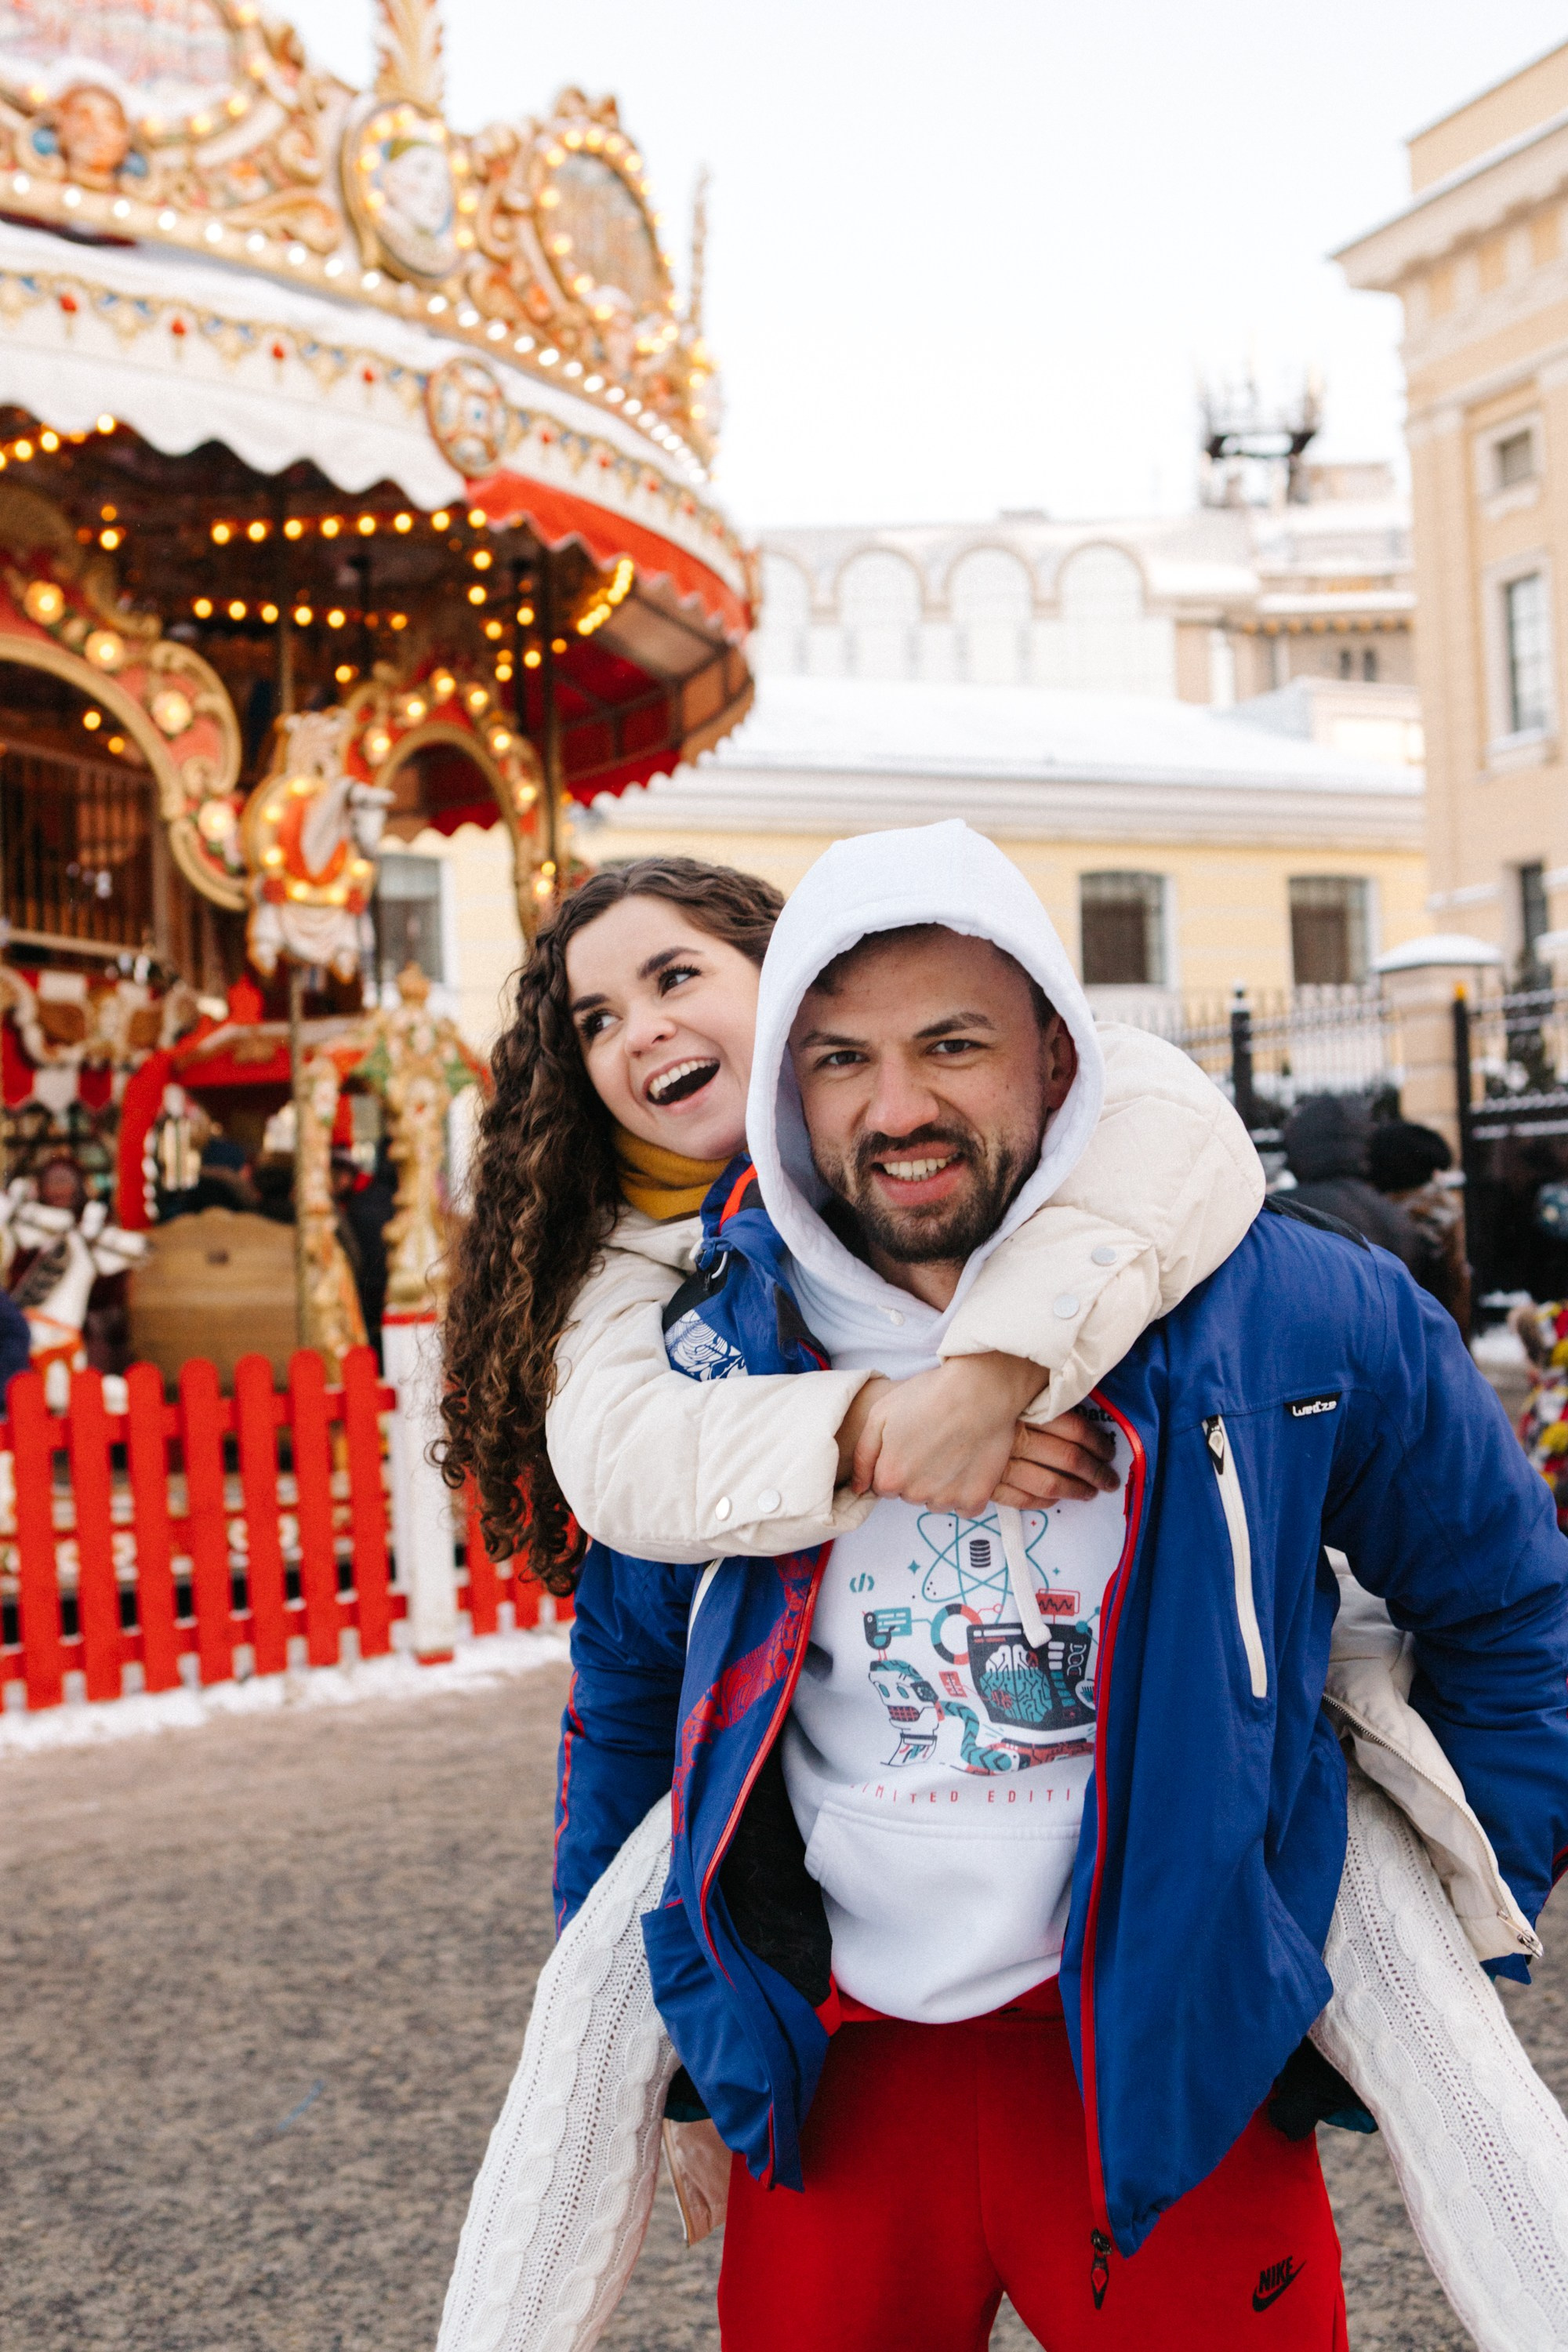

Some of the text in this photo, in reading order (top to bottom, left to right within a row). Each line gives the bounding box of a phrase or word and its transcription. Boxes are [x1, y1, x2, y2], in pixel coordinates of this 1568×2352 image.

[850, 1783, 1085, 1803] IMITED EDITI
[1258, 2256, 1293, 2293] NIKE
